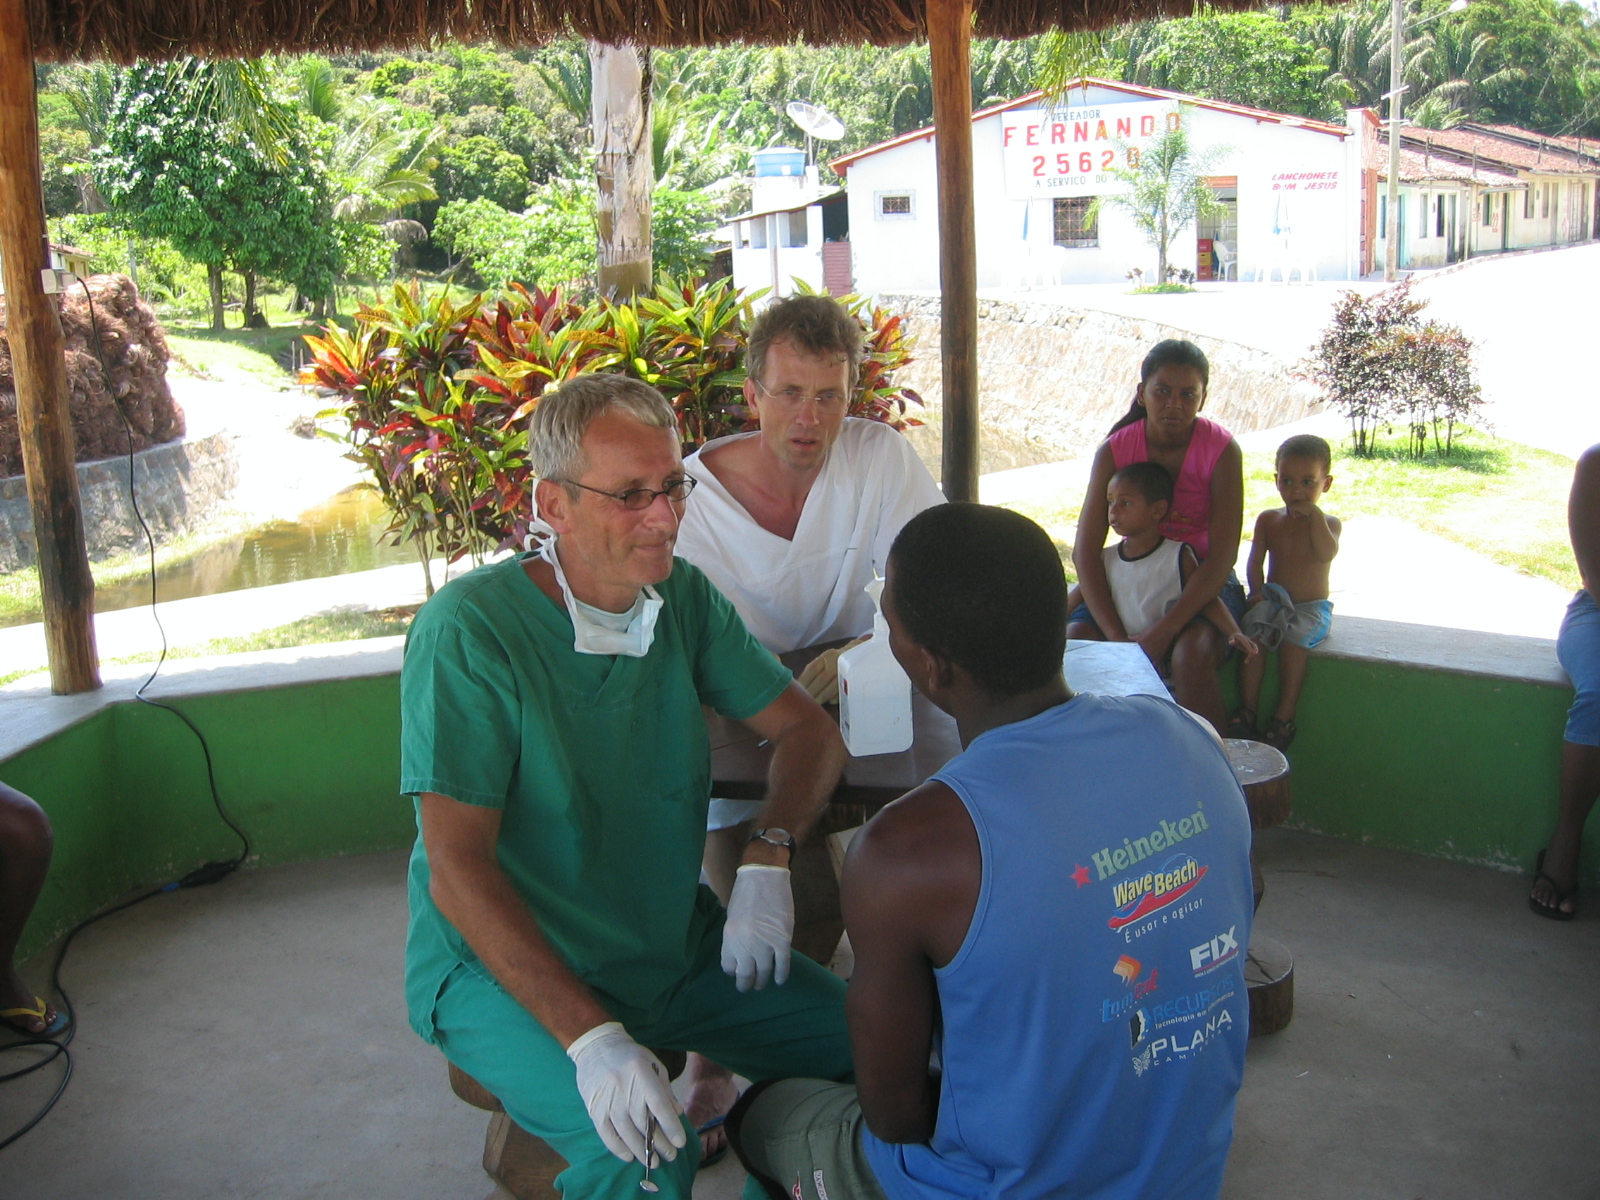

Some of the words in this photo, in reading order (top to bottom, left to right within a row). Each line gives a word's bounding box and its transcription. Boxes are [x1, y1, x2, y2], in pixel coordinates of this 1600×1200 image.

[1003, 112, 1182, 148] FERNANDO
[1051, 109, 1101, 122] VEREADOR
[1035, 179, 1041, 188] A
[1095, 174, 1108, 184] DO
[1271, 171, 1339, 181] LANCHONETE
[1271, 182, 1297, 191] BM
[1304, 181, 1339, 191] JESUS
[1091, 810, 1210, 881] Heineken
[1135, 919, 1158, 938] usar
[1162, 915, 1168, 924] e
[1172, 898, 1204, 920] agitar
[1189, 925, 1238, 970] FIX
[1151, 1009, 1233, 1059] PLANA
